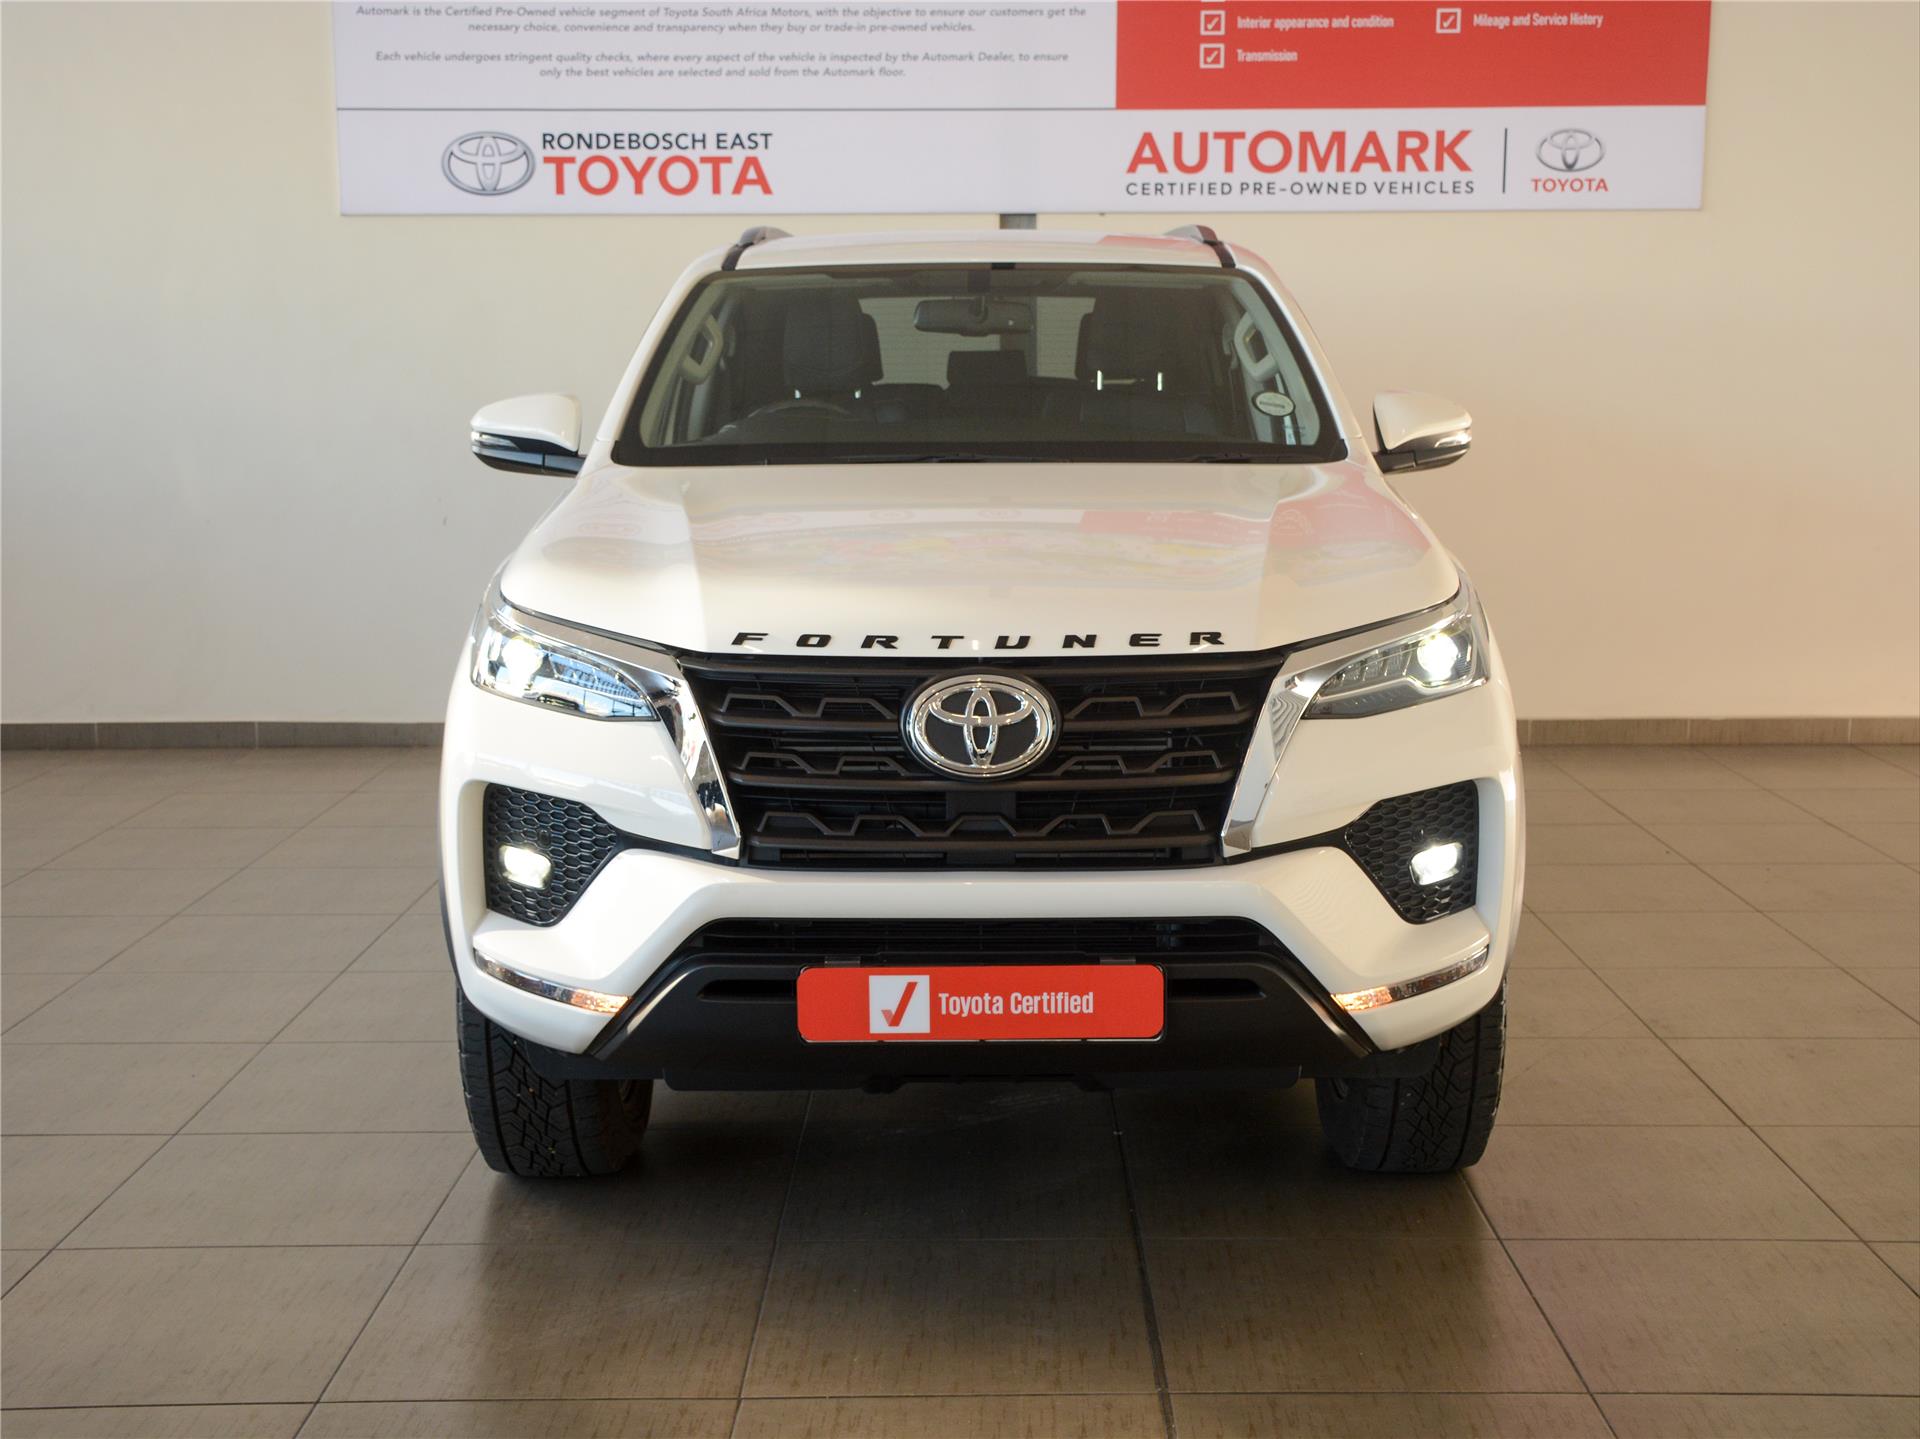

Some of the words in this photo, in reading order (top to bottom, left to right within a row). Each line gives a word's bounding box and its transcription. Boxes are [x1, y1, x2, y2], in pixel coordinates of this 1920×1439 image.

[355, 4, 410, 16] Automark
[412, 5, 422, 17] is
[423, 5, 443, 17] the
[444, 5, 493, 17] Certified
[494, 6, 557, 17] Pre-Owned
[558, 7, 597, 17] vehicle
[599, 7, 646, 20] segment
[648, 6, 661, 17] of
[663, 6, 699, 20] Toyota
[701, 6, 734, 18] South
[735, 7, 768, 17] Africa
[770, 7, 812, 18] Motors,
[815, 7, 839, 17] with
[841, 7, 860, 17] the
[862, 7, 912, 20] objective
[914, 8, 927, 17] to
[929, 9, 966, 17] ensure
[967, 9, 987, 17] our
[989, 7, 1045, 17] customers
[1047, 7, 1066, 20] get
[1068, 6, 1087, 17] the
[1473, 13, 1510, 29] Mileage
[1512, 13, 1531, 26] and
[1533, 13, 1568, 26] Service
[1570, 12, 1604, 28] History
[467, 23, 521, 35] necessary
[522, 21, 561, 33] choice,
[563, 23, 631, 33] convenience
[632, 22, 654, 33] and
[656, 23, 726, 35] transparency
[727, 22, 758, 33] when
[759, 22, 785, 35] they
[786, 21, 808, 35] buy
[809, 24, 822, 32] or
[824, 21, 867, 32] trade-in
[868, 21, 929, 34] pre-owned
[930, 21, 975, 33] vehicles.
[1237, 15, 1272, 29] Interior
[1274, 17, 1329, 31] appearance
[1331, 15, 1349, 28] and
[1351, 15, 1394, 28] condition
[375, 50, 402, 62] Each
[403, 50, 442, 62] vehicle
[444, 50, 502, 65] undergoes
[503, 51, 553, 65] stringent
[555, 51, 593, 65] quality
[594, 52, 633, 63] checks,
[636, 52, 670, 63] where
[672, 54, 703, 65] every
[705, 53, 741, 63] aspect
[743, 51, 756, 62] of
[757, 51, 776, 62] the
[778, 51, 816, 62] vehicle
[818, 52, 827, 62] is
[829, 52, 883, 65] inspected
[884, 52, 899, 65] by
[901, 51, 920, 62] the
[921, 51, 974, 62] Automark
[977, 51, 1015, 63] Dealer,
[1018, 52, 1031, 62] to
[1032, 53, 1069, 62] ensure
[1237, 48, 1298, 62] Transmission
[538, 66, 563, 80] only
[564, 66, 584, 77] the
[585, 67, 610, 77] best
[611, 66, 655, 77] vehicles
[656, 69, 675, 77] are
[677, 67, 723, 77] selected
[724, 66, 746, 77] and
[748, 66, 772, 77] sold
[773, 66, 800, 77] from
[801, 66, 821, 77] the
[822, 66, 876, 77] Automark
[878, 66, 906, 77] floor.
[541, 132, 707, 151] RONDEBOSCH
[715, 132, 774, 151] EAST
[1126, 129, 1473, 175] AUTOMARK
[542, 154, 773, 197] TOYOTA
[1125, 180, 1233, 197] CERTIFIED
[1239, 179, 1367, 197] PRE-OWNED
[1373, 179, 1475, 196] VEHICLES
[1531, 177, 1609, 194] TOYOTA
[731, 631, 1226, 650] FORTUNER
[938, 992, 1004, 1018] Toyota
[1009, 991, 1094, 1016] Certified
